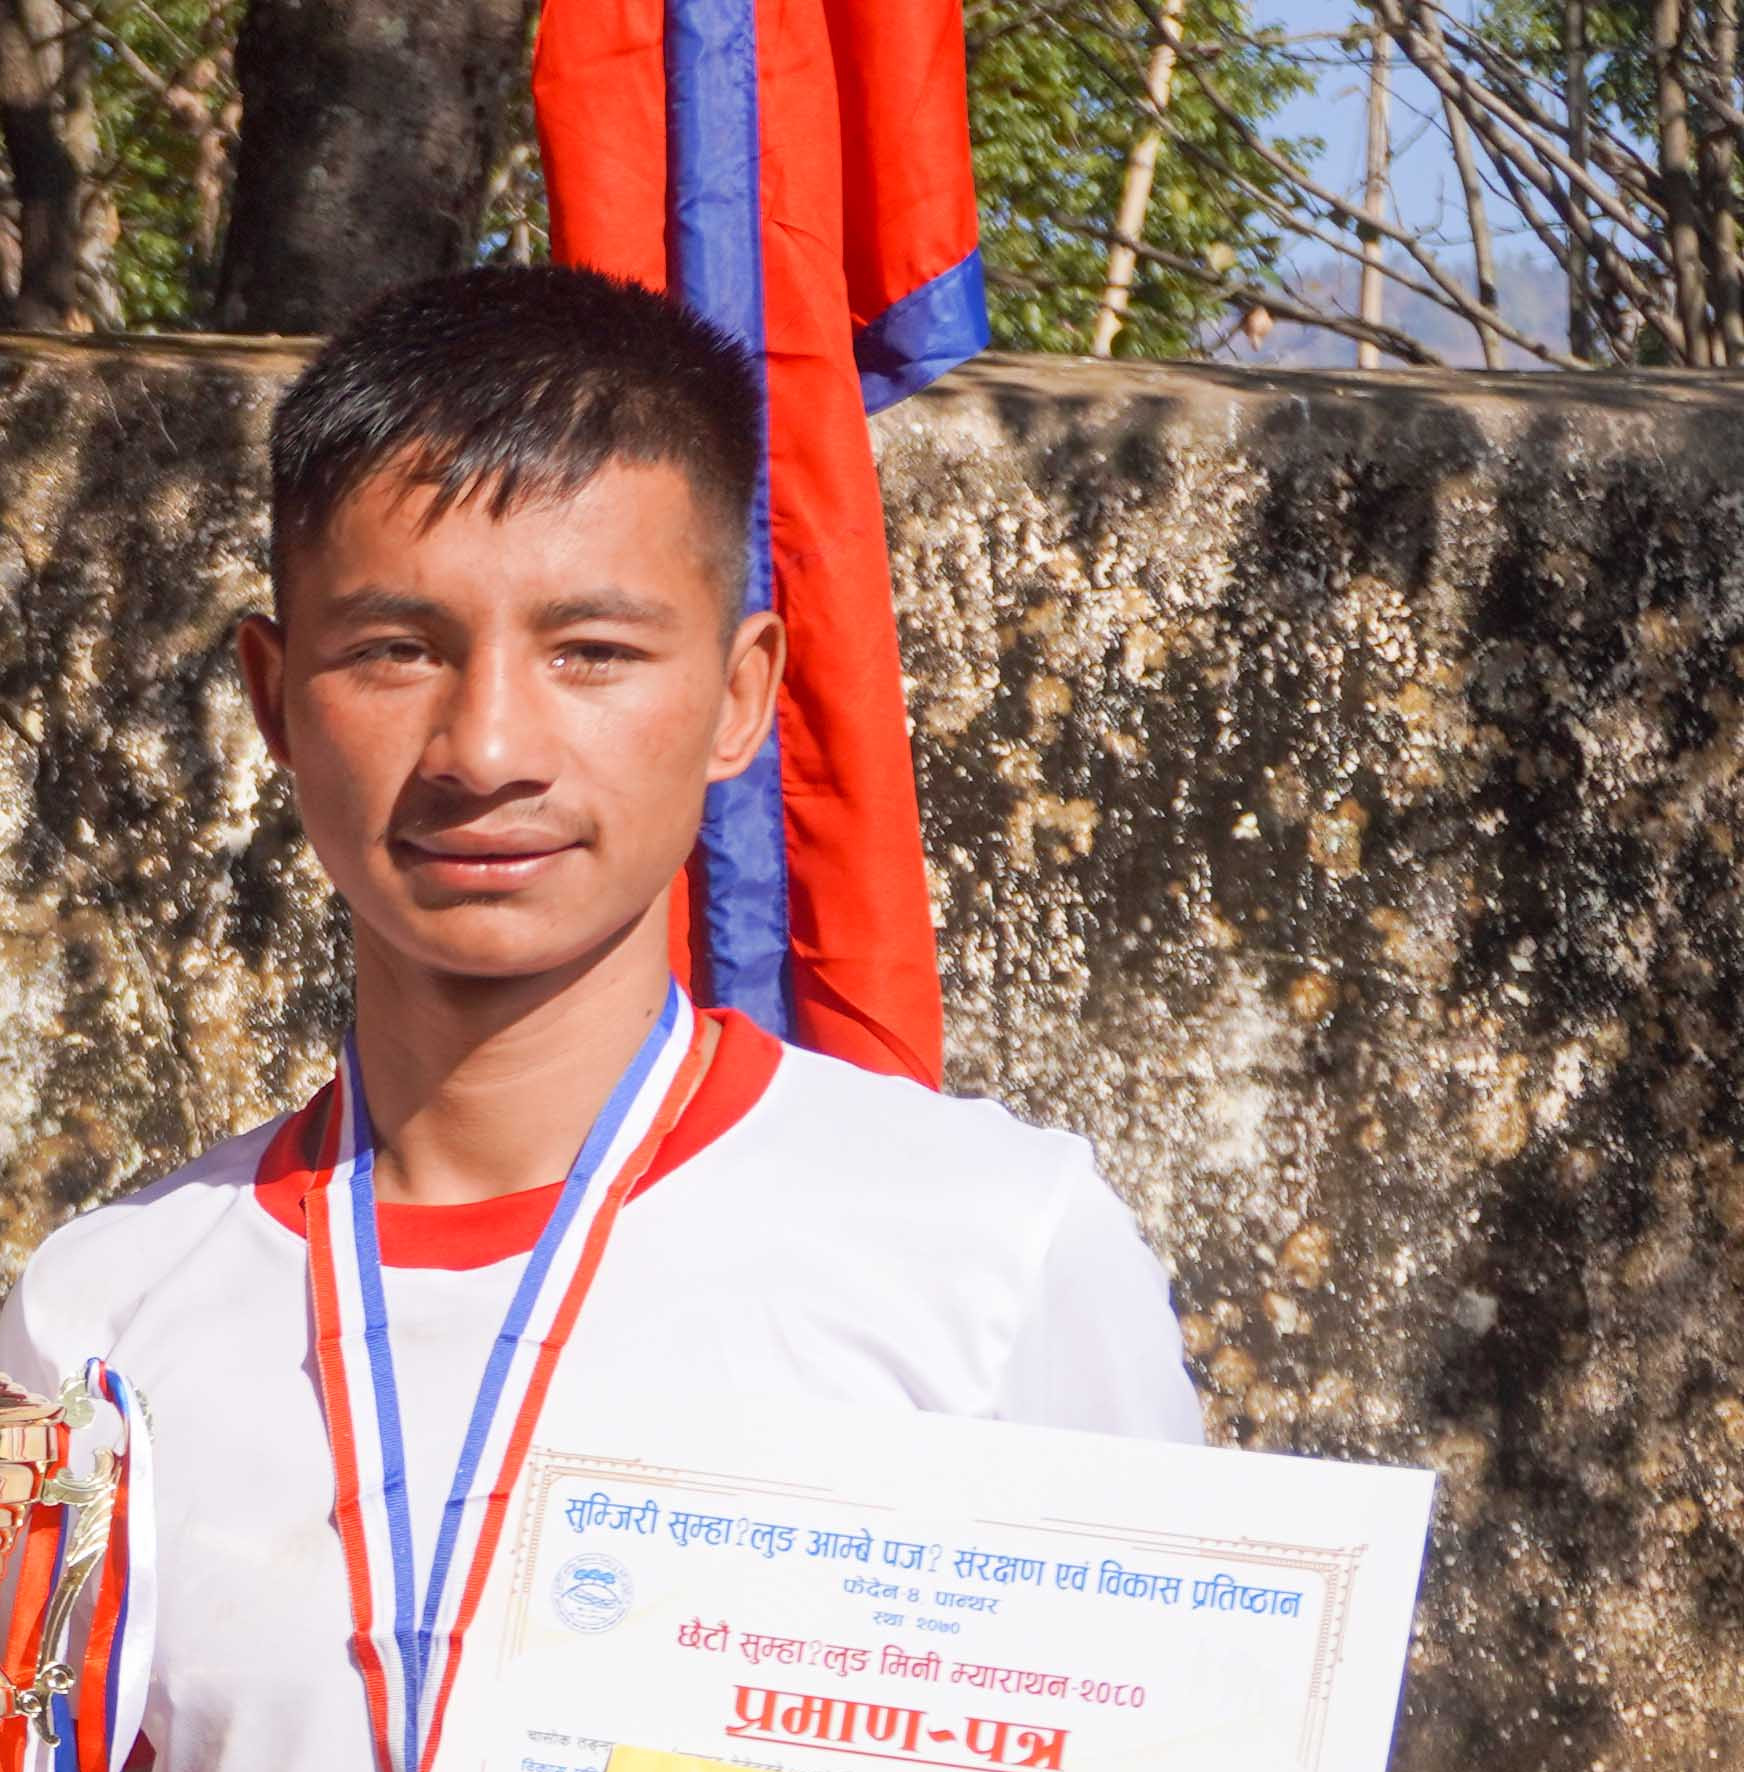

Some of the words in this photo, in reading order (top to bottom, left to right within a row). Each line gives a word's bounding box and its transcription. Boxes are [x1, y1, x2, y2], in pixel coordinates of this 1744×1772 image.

[806, 1527, 876, 1565] आम्बे
[953, 1546, 1045, 1587] संरक्षण
[1055, 1560, 1091, 1592] एवं
[1098, 1559, 1184, 1605] विकास
[1191, 1572, 1304, 1619] प्रतिष्ठान
[880, 1644, 943, 1682] मिनी
